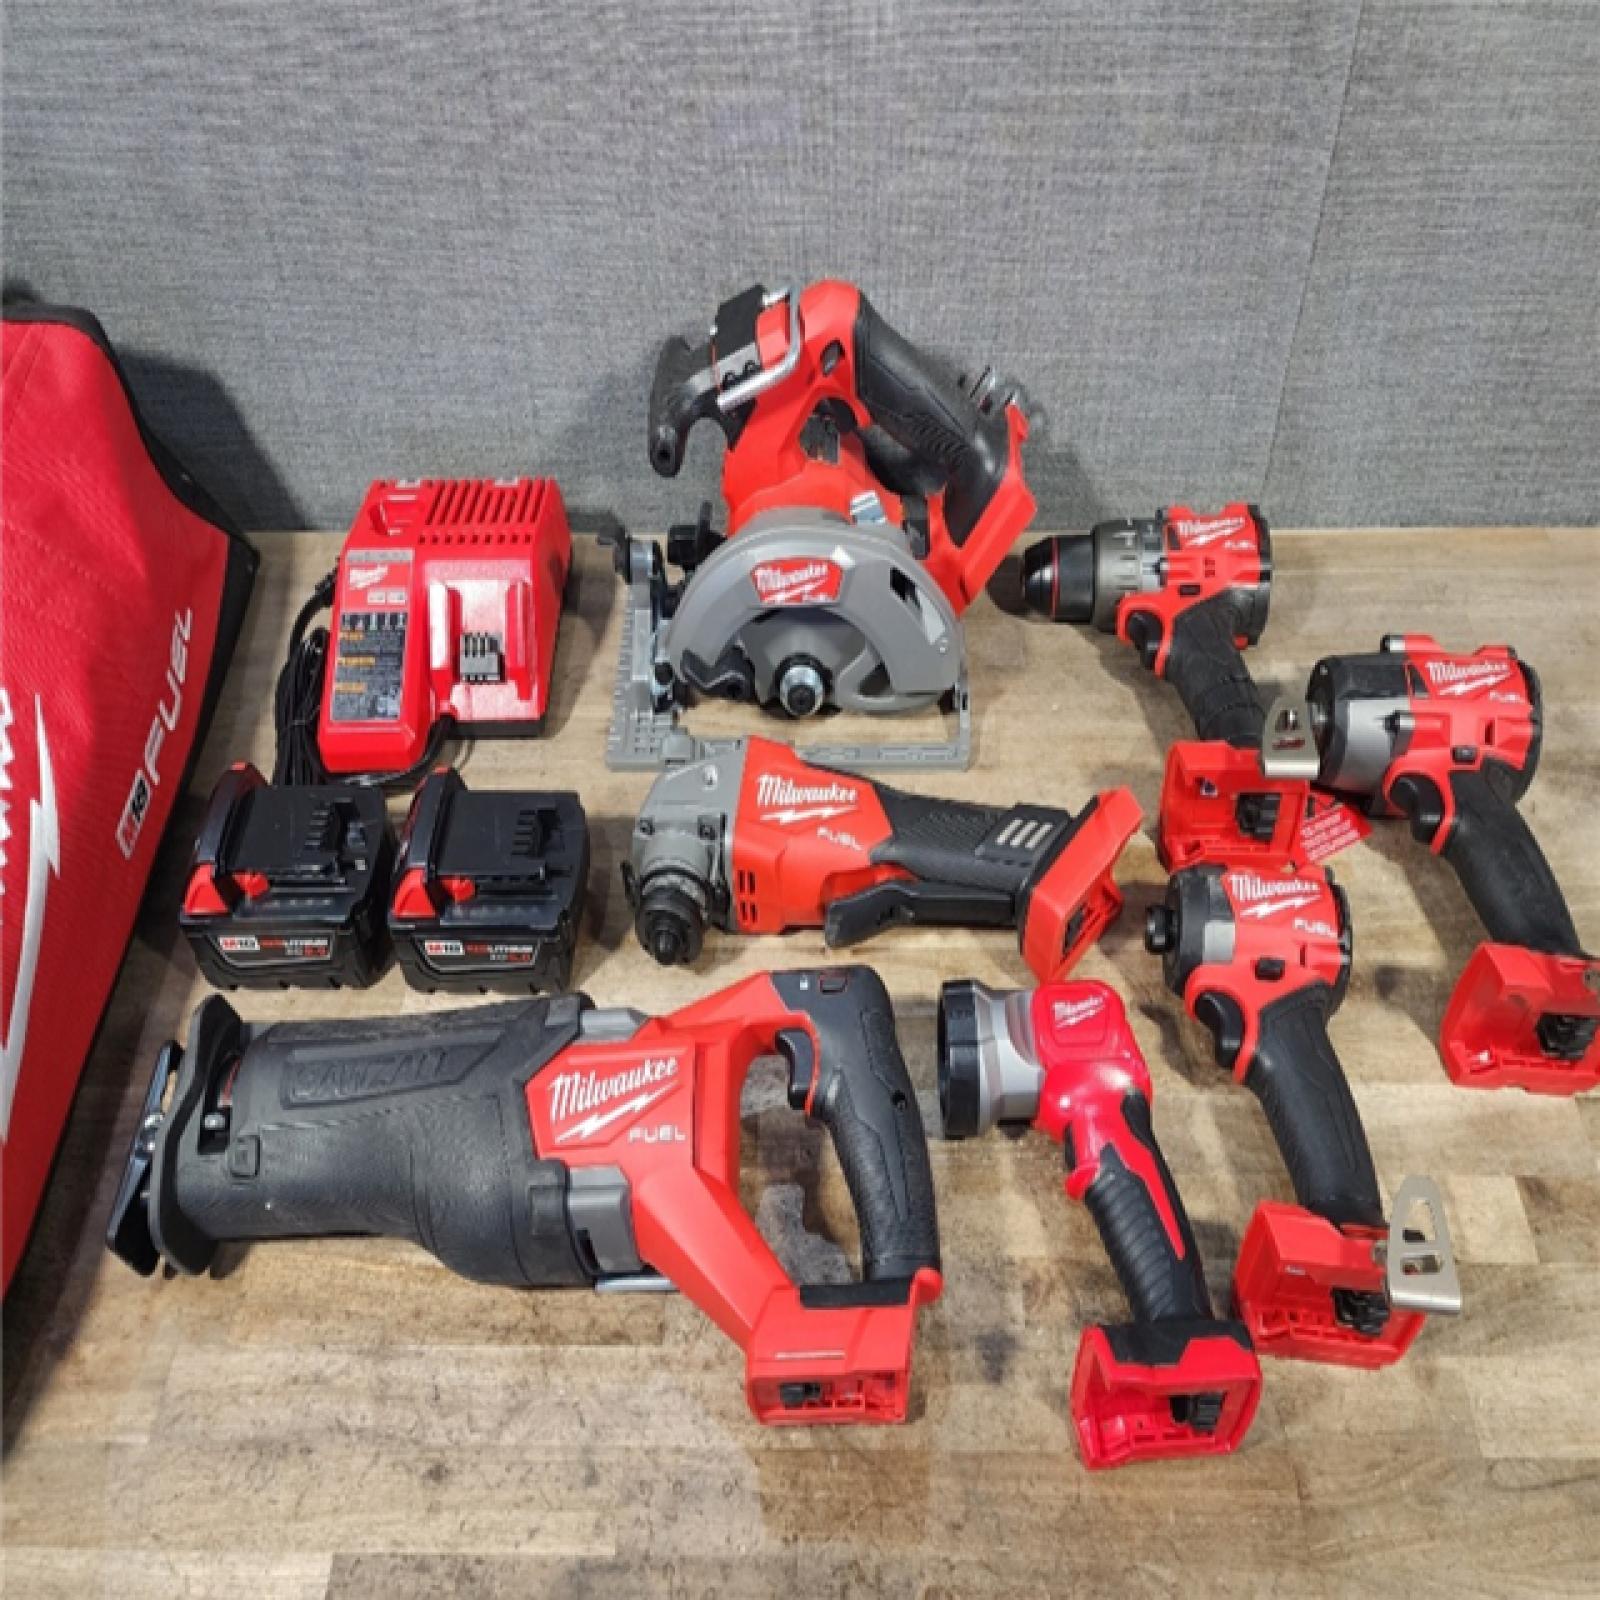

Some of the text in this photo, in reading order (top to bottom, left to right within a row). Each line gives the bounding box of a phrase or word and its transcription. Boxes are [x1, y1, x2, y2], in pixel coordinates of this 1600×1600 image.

[1425, 660, 1509, 685] Milwaukee
[144, 607, 193, 786] FUEL
[756, 772, 857, 808] Milwaukee
[816, 827, 863, 851] FUEL
[1228, 874, 1319, 902] Milwaukee
[548, 1056, 678, 1124] Milwaukee
[628, 1124, 686, 1143] FUEL
